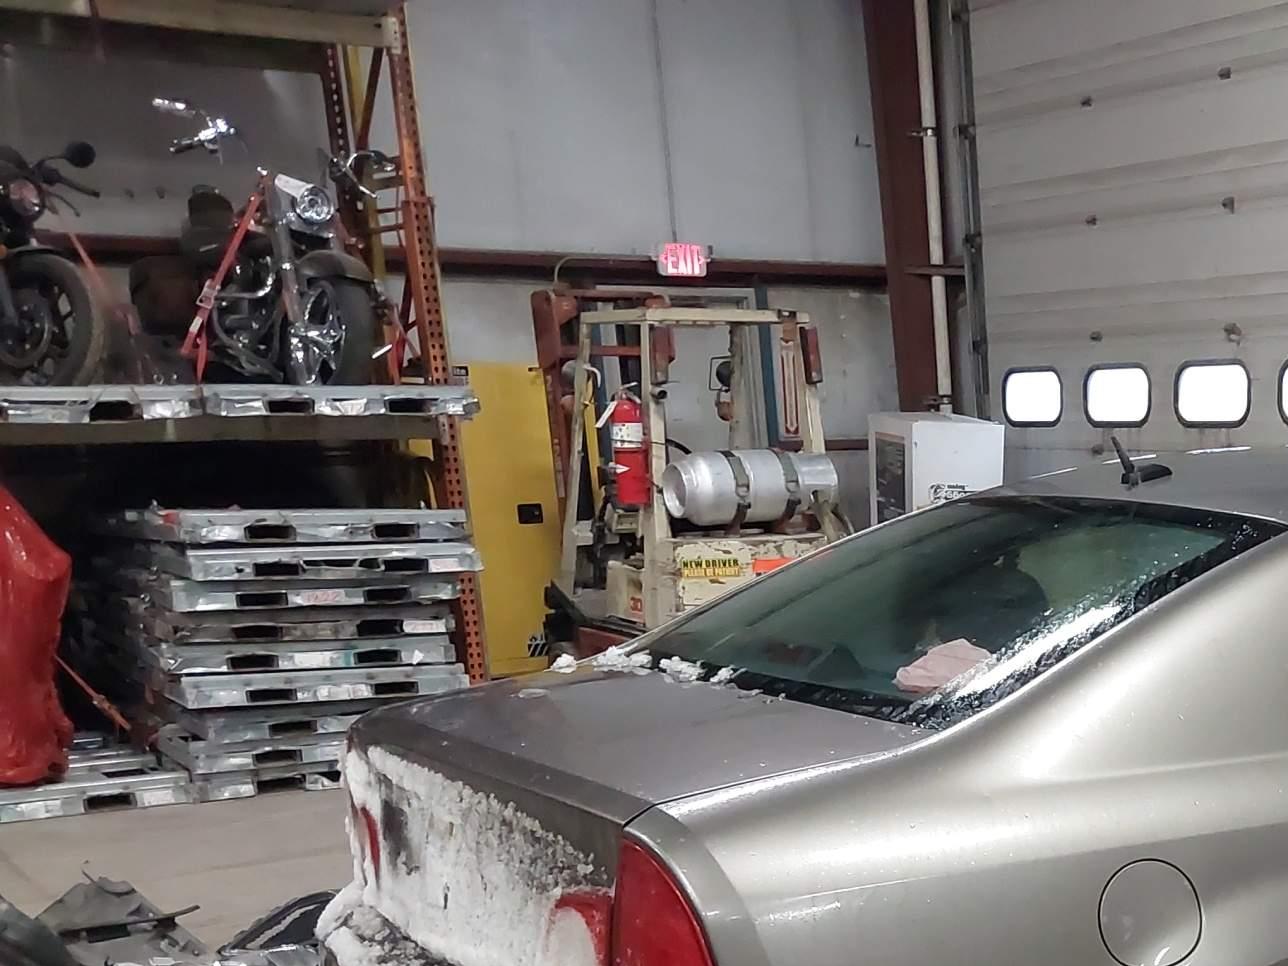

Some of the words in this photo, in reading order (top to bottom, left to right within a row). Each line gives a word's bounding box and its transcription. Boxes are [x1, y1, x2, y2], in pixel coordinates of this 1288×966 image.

[667, 245, 701, 275] EXIT
[682, 559, 703, 569] NEW
[704, 558, 739, 569] DRIVER
